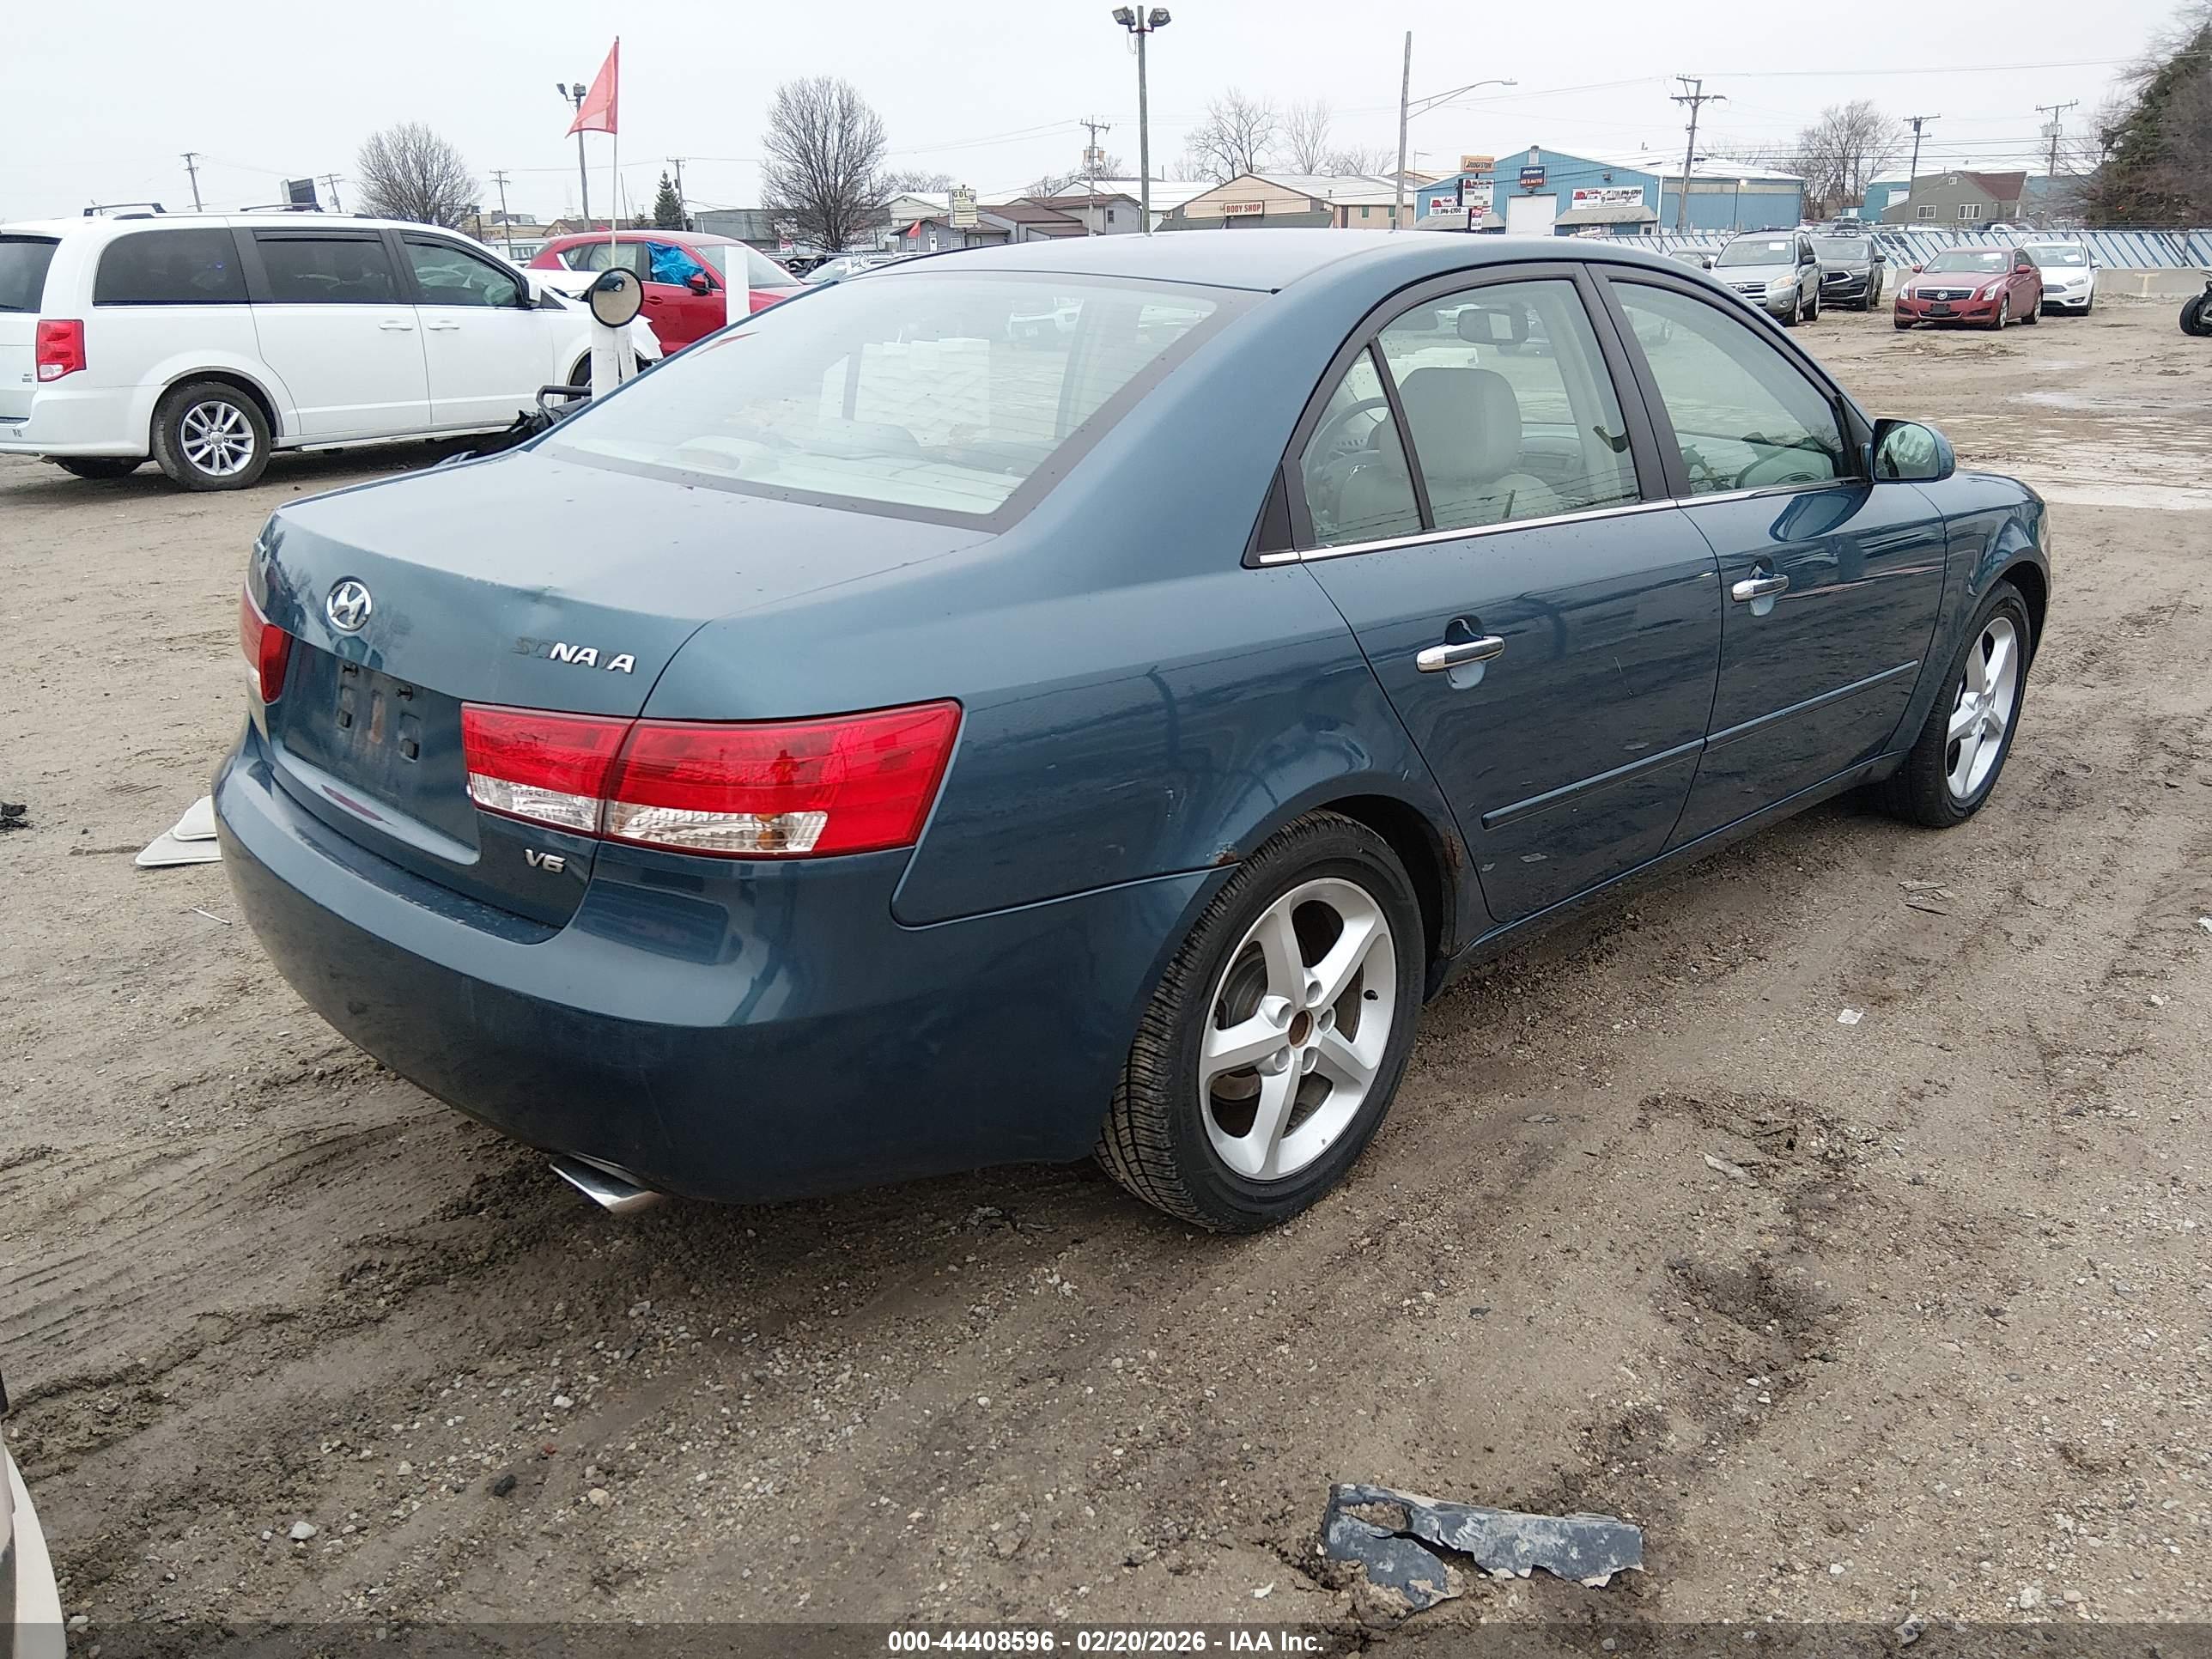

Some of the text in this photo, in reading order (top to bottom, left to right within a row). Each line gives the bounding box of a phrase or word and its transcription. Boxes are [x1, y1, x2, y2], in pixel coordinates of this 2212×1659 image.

[1226, 204, 1261, 213] BODY SHOP
[523, 848, 567, 874] V6
